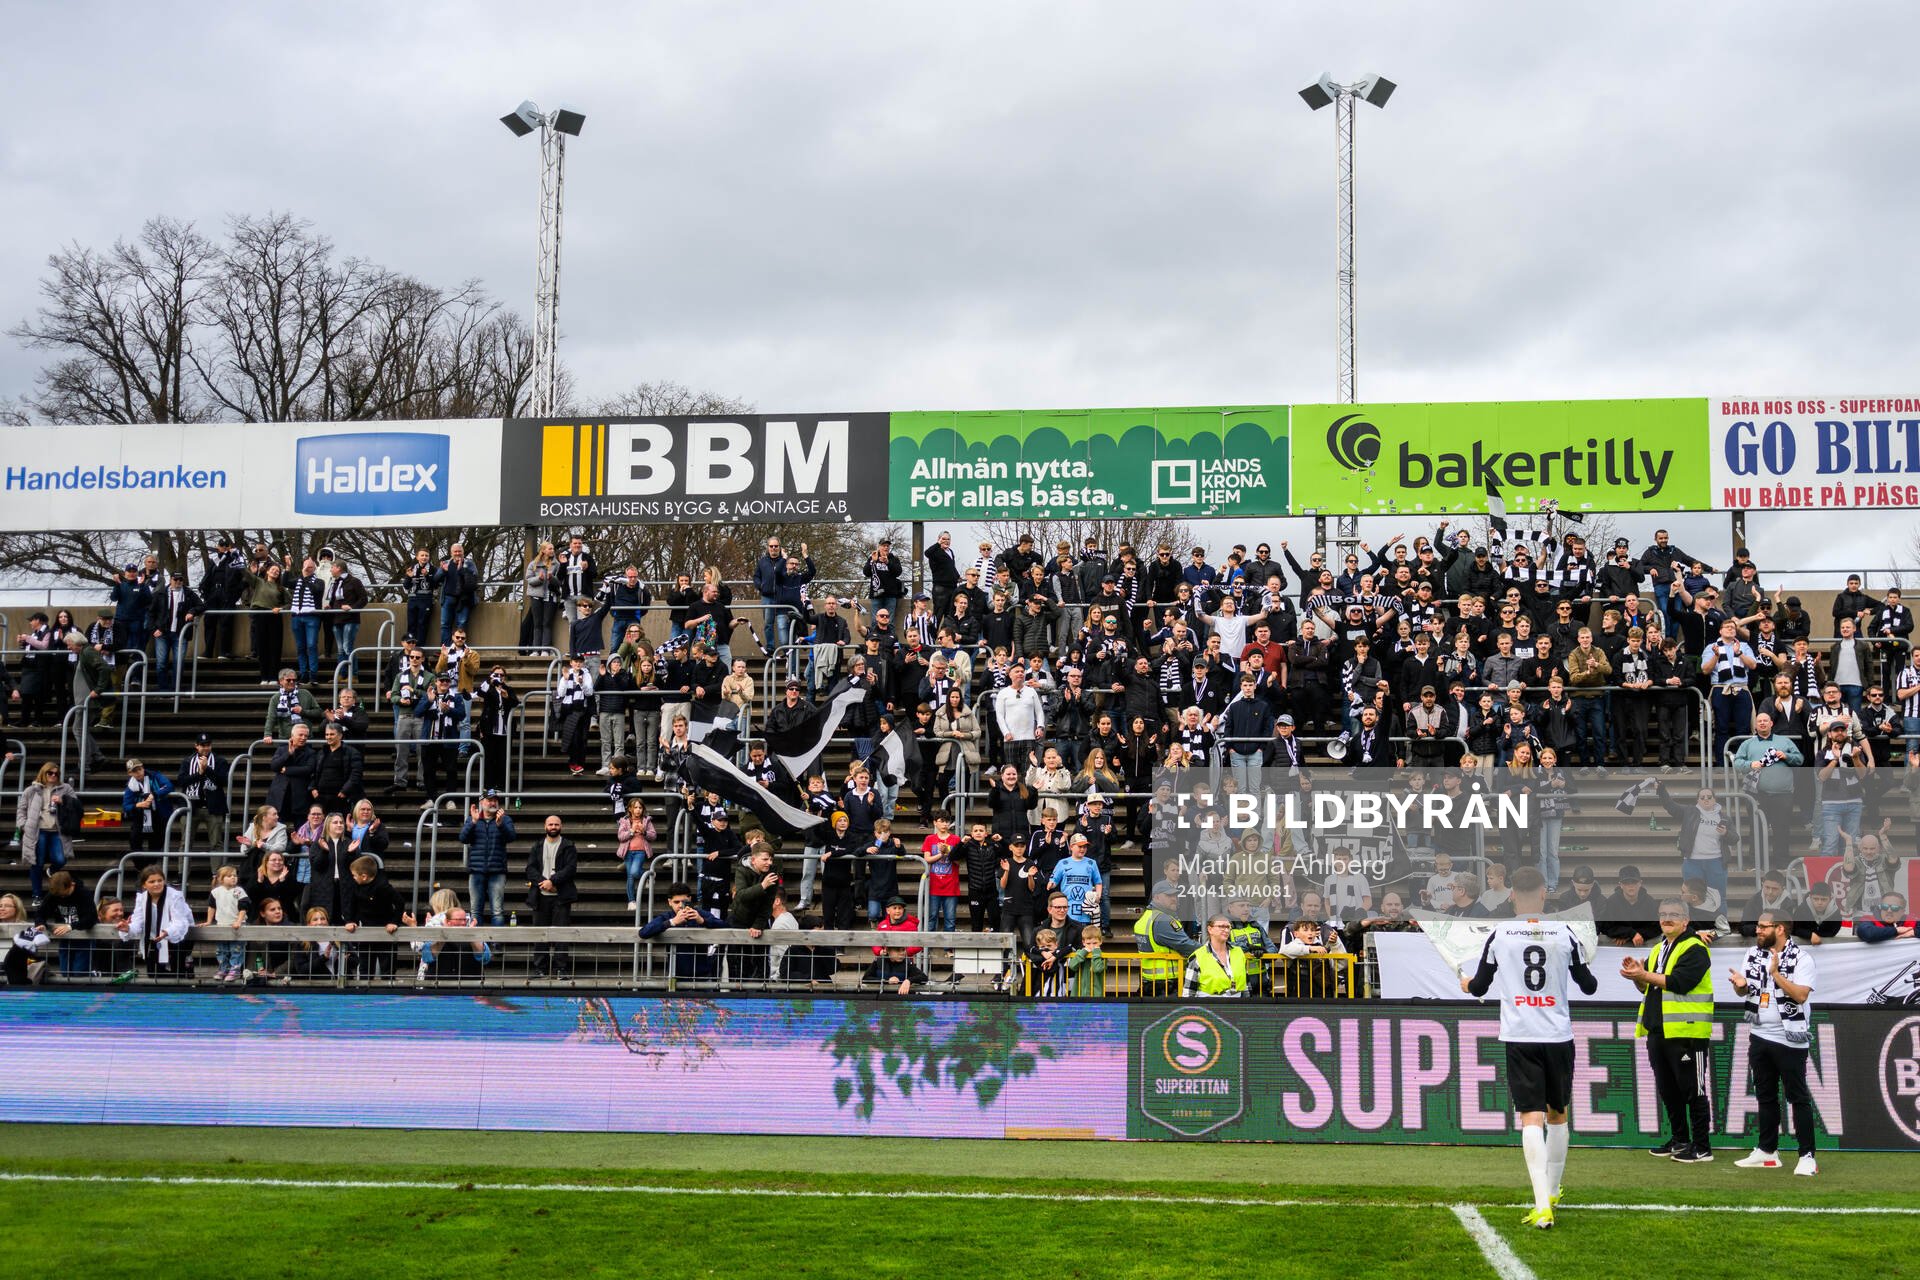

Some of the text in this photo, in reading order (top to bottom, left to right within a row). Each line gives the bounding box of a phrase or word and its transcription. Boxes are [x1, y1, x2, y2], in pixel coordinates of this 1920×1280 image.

[1722, 401, 1760, 415] BARA
[1764, 401, 1793, 414] HOS
[1797, 400, 1826, 414] OSS
[607, 420, 849, 496] BBM
[1724, 419, 1920, 476] GO BILT
[5, 465, 227, 491] Handelsbanken
[306, 456, 437, 494] Haldex
[910, 457, 1094, 484] Allmän nytta.
[1201, 459, 1261, 474] LANDS
[1399, 437, 1674, 499] bakertilly
[1201, 474, 1267, 489] KRONA
[910, 485, 954, 508] För
[961, 486, 1024, 508] allas
[1201, 490, 1240, 505] HEM
[1724, 488, 1751, 508] NU
[1759, 482, 1814, 507] BÅDE
[1820, 482, 1847, 506] PÅ
[540, 500, 848, 517] BORSTAHUSENS BYGG & MONTAGE AB
[1523, 945, 1547, 992] 8
[1514, 995, 1556, 1007] PULS
[1155, 1078, 1229, 1095] SUPERETTAN
[1282, 1016, 1844, 1137] SUPEETAN
